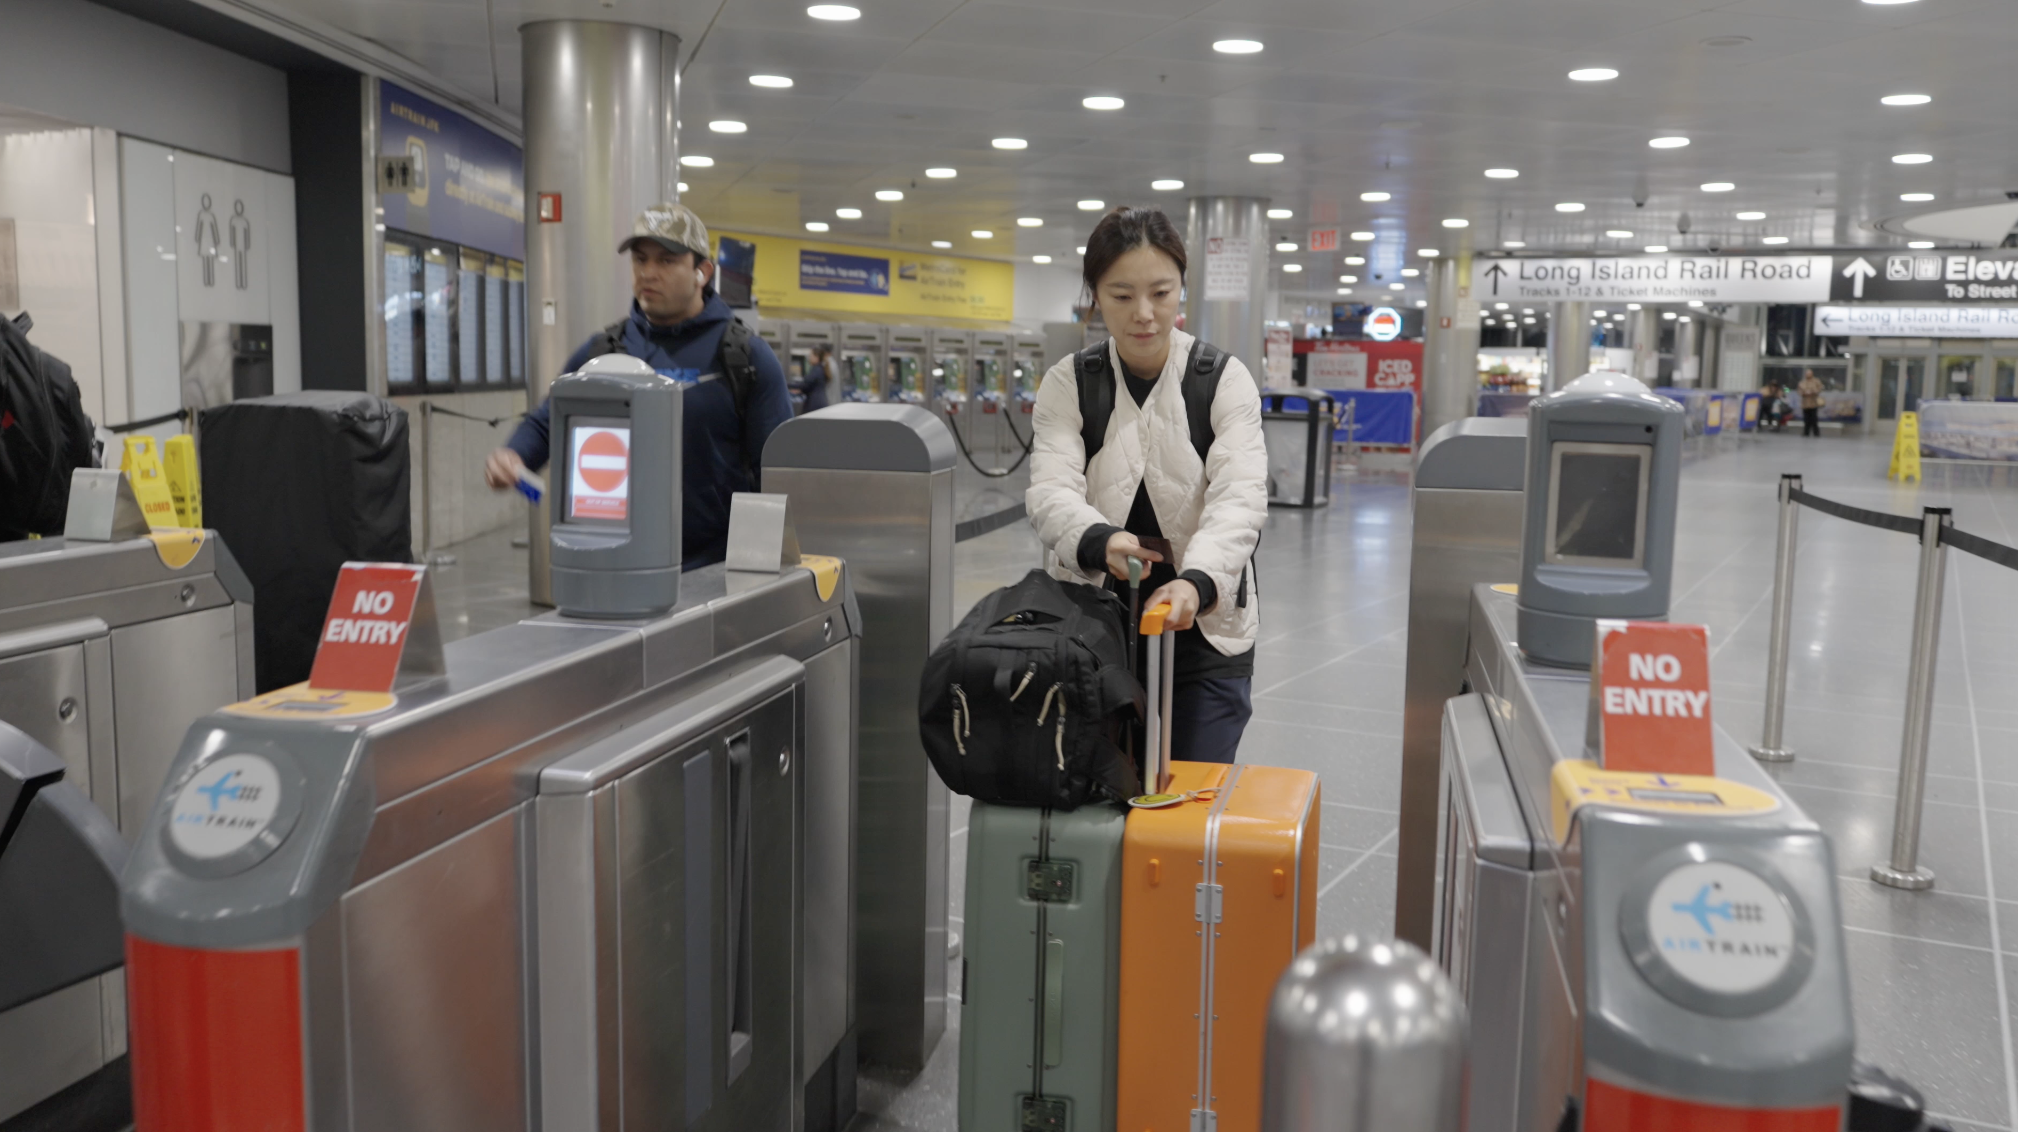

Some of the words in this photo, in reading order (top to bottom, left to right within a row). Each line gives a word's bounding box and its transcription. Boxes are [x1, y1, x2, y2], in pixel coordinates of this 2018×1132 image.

[1311, 230, 1337, 251] EXIT
[1519, 260, 1581, 286] Long
[1591, 259, 1668, 281] Island
[1680, 258, 1729, 280] Rail
[1741, 258, 1812, 280] Road
[1519, 286, 1560, 298] Tracks
[1565, 286, 1591, 298] 1-12
[1595, 287, 1604, 298] &
[1609, 286, 1649, 298] Ticket
[1653, 286, 1717, 298] Machines
[1945, 284, 1965, 298] To
[1967, 284, 2017, 298] Street
[1849, 308, 1891, 326] Long
[1898, 308, 1950, 323] Island
[1957, 308, 1991, 323] Rail
[1313, 369, 1359, 377] CRACKING
[1378, 359, 1413, 373] ICED
[1374, 373, 1415, 386] CAPP
[145, 501, 171, 514] CLOSED
[351, 590, 395, 616] NO
[324, 618, 408, 646] ENTRY
[1628, 653, 1682, 683] NO
[1603, 686, 1709, 719] ENTRY
